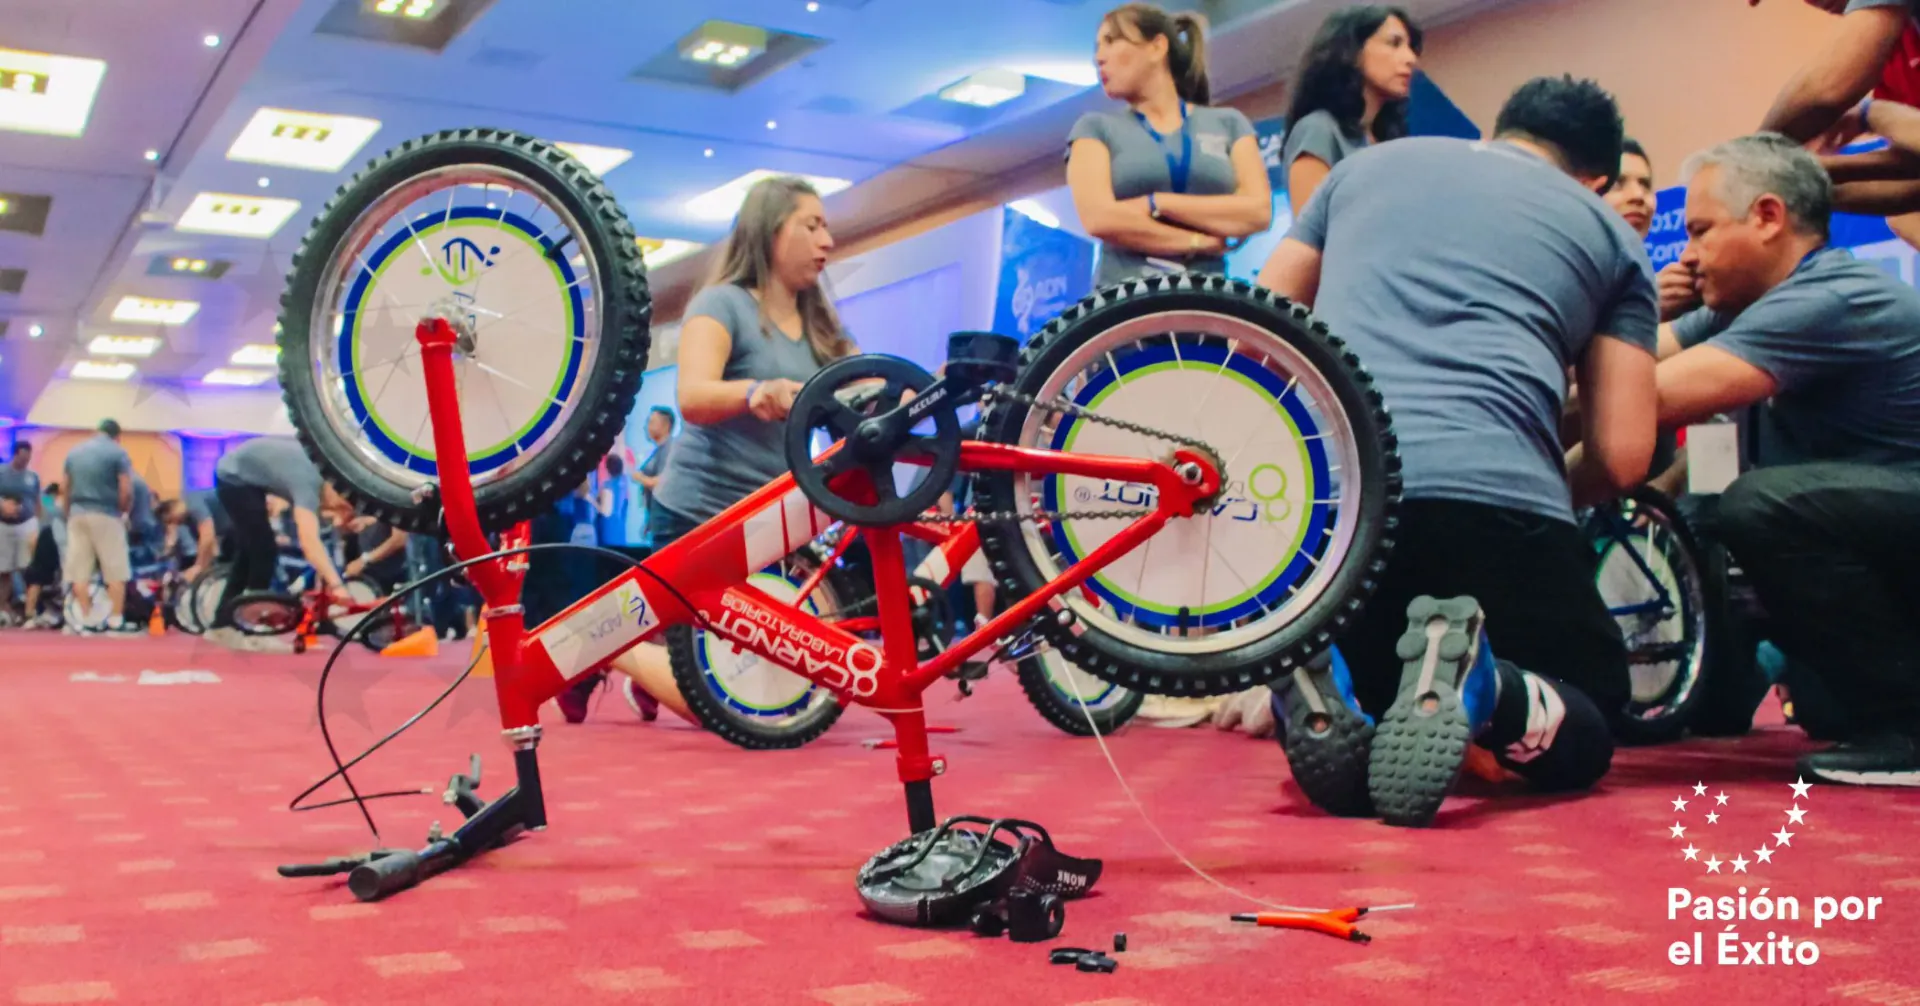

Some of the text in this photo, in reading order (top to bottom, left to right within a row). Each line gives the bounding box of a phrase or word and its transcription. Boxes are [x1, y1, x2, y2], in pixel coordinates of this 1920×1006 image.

[908, 387, 947, 417] ACCURA
[1099, 480, 1258, 522] CAOT
[720, 592, 845, 662] LABORATORIOS
[710, 610, 850, 689] CARNOT
[1057, 869, 1087, 887] MONK
